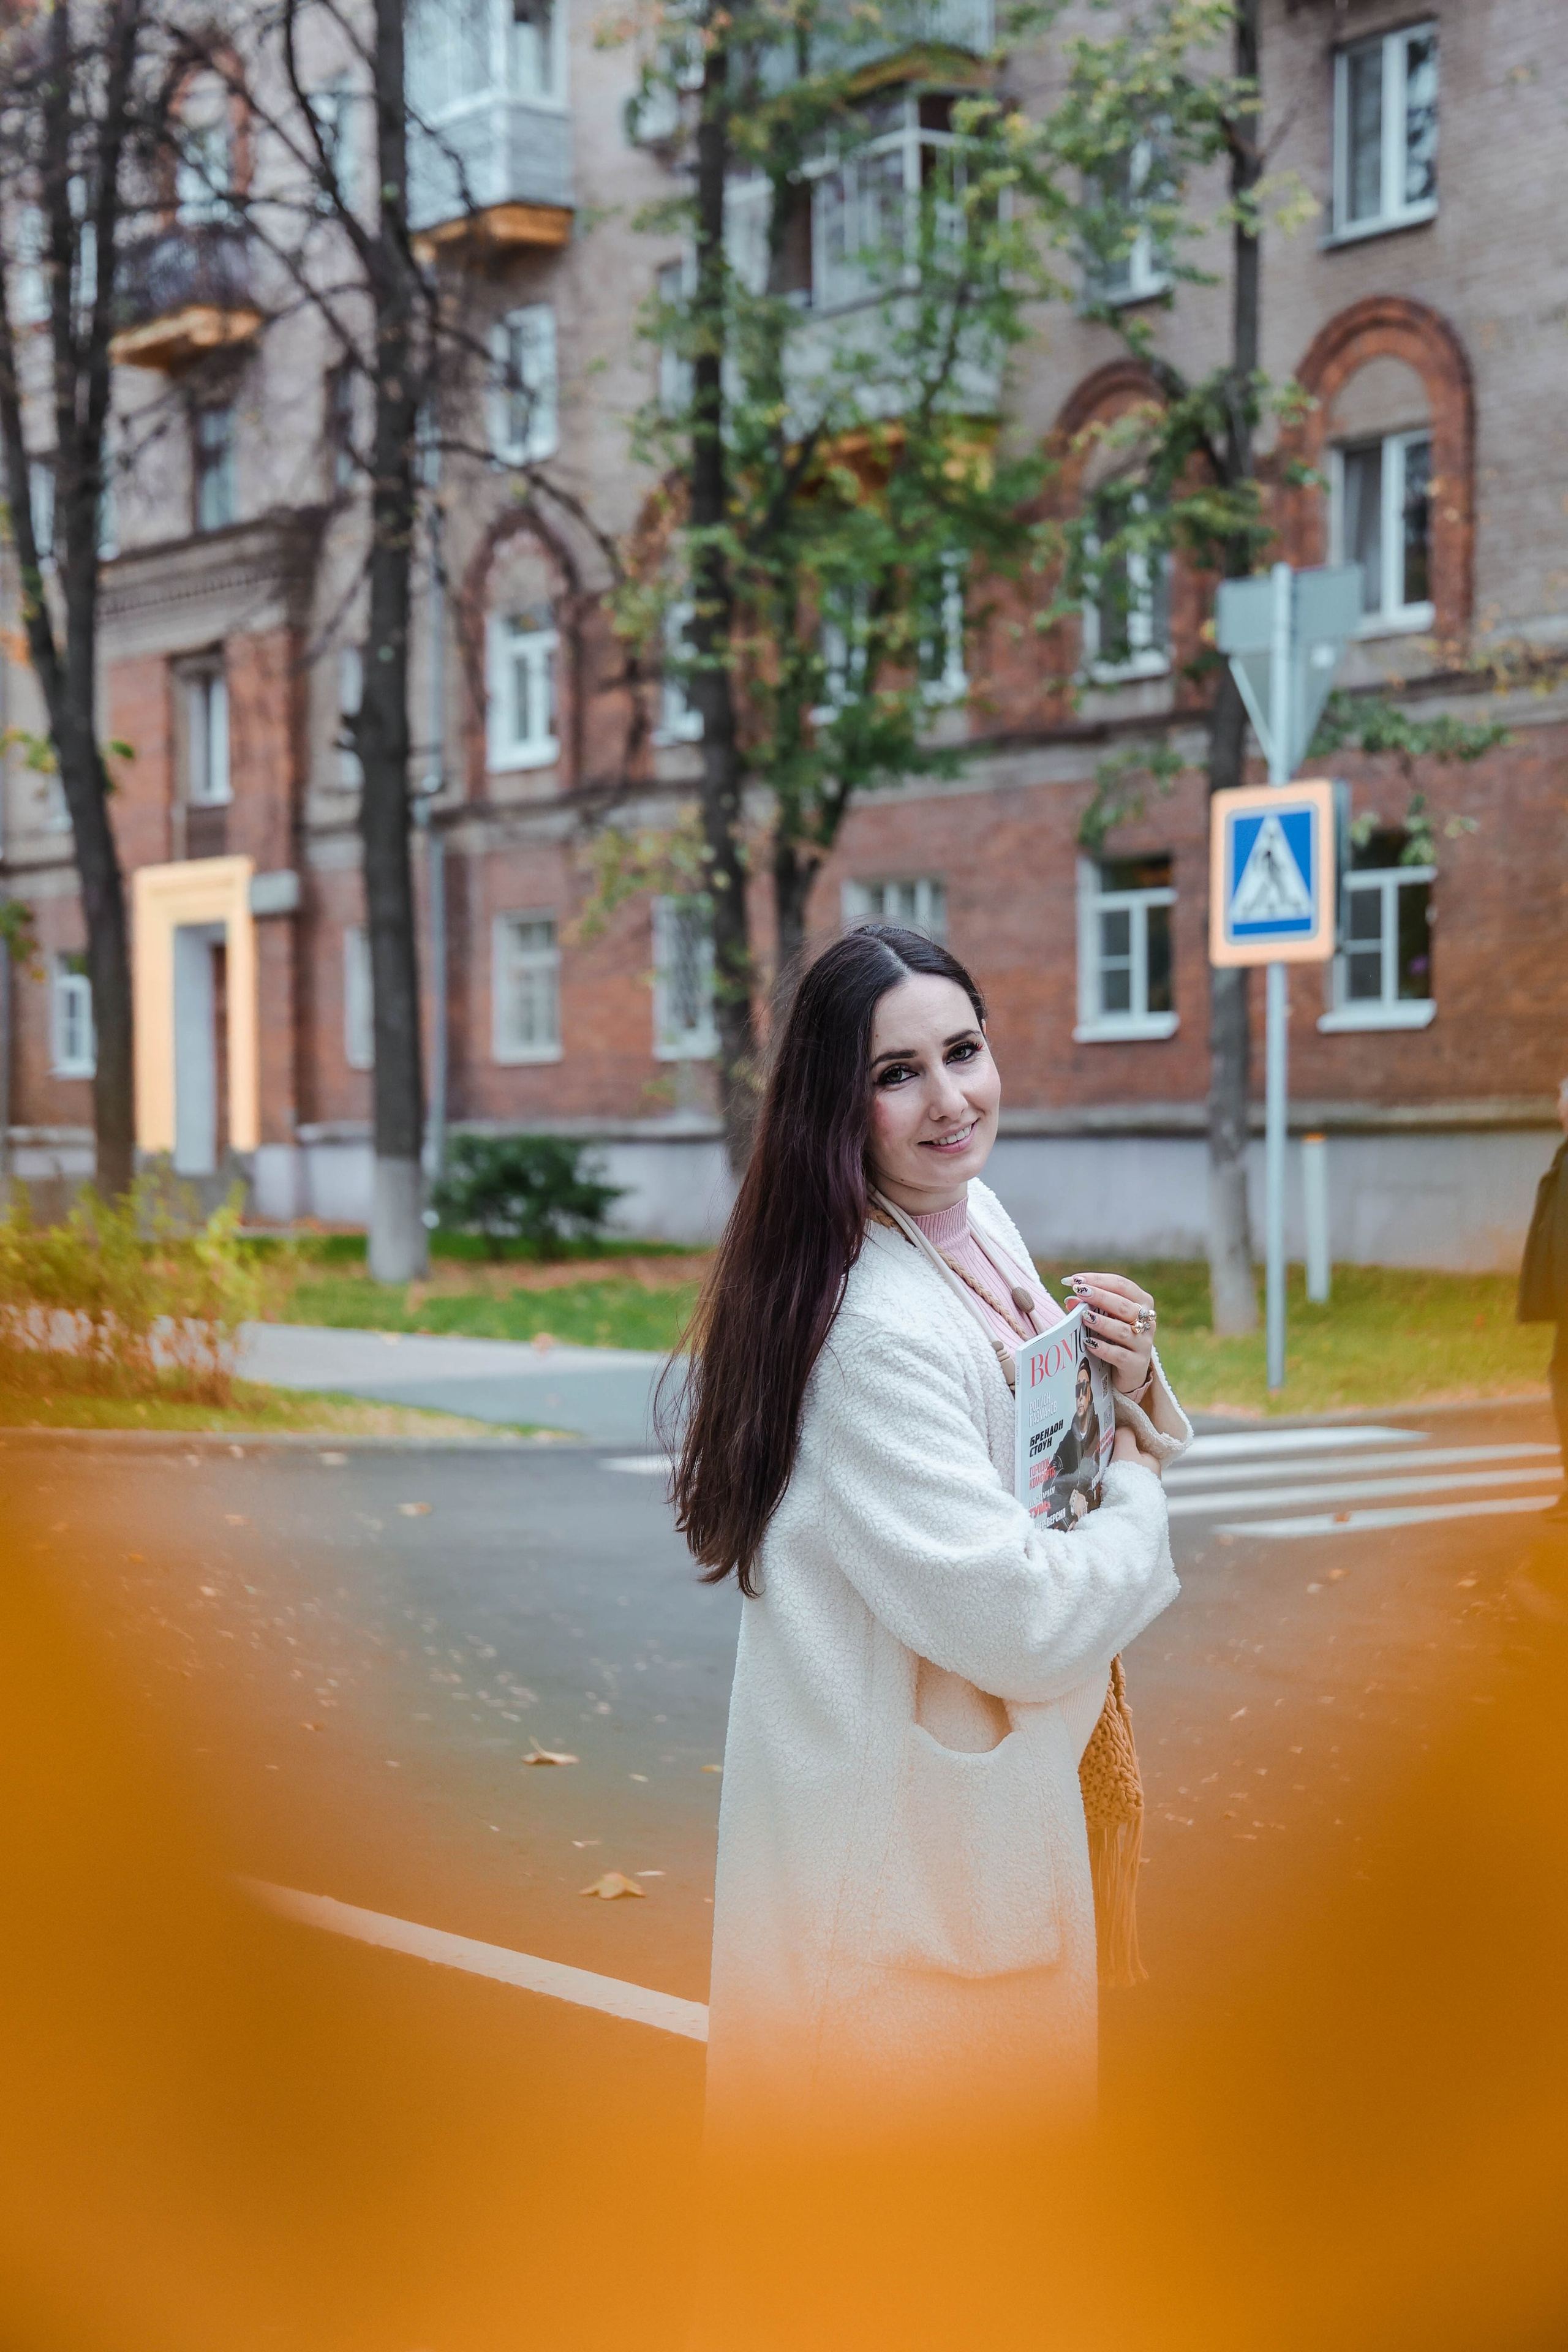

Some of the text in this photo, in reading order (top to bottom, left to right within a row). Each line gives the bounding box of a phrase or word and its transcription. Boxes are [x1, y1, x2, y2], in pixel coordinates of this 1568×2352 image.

[1030, 1307, 1107, 1389] BONJO
[1030, 1401, 1057, 1427] ГАЗМАНОВ
[1030, 1419, 1064, 1447] БРЕНДОН
[1030, 1436, 1052, 1458] СТОУН
[1029, 1466, 1055, 1490] КОМФОРТА
[1030, 1457, 1050, 1478] ГОРОДОК
[1035, 1507, 1066, 1530] ВЕР-ВЕРСИЯ
